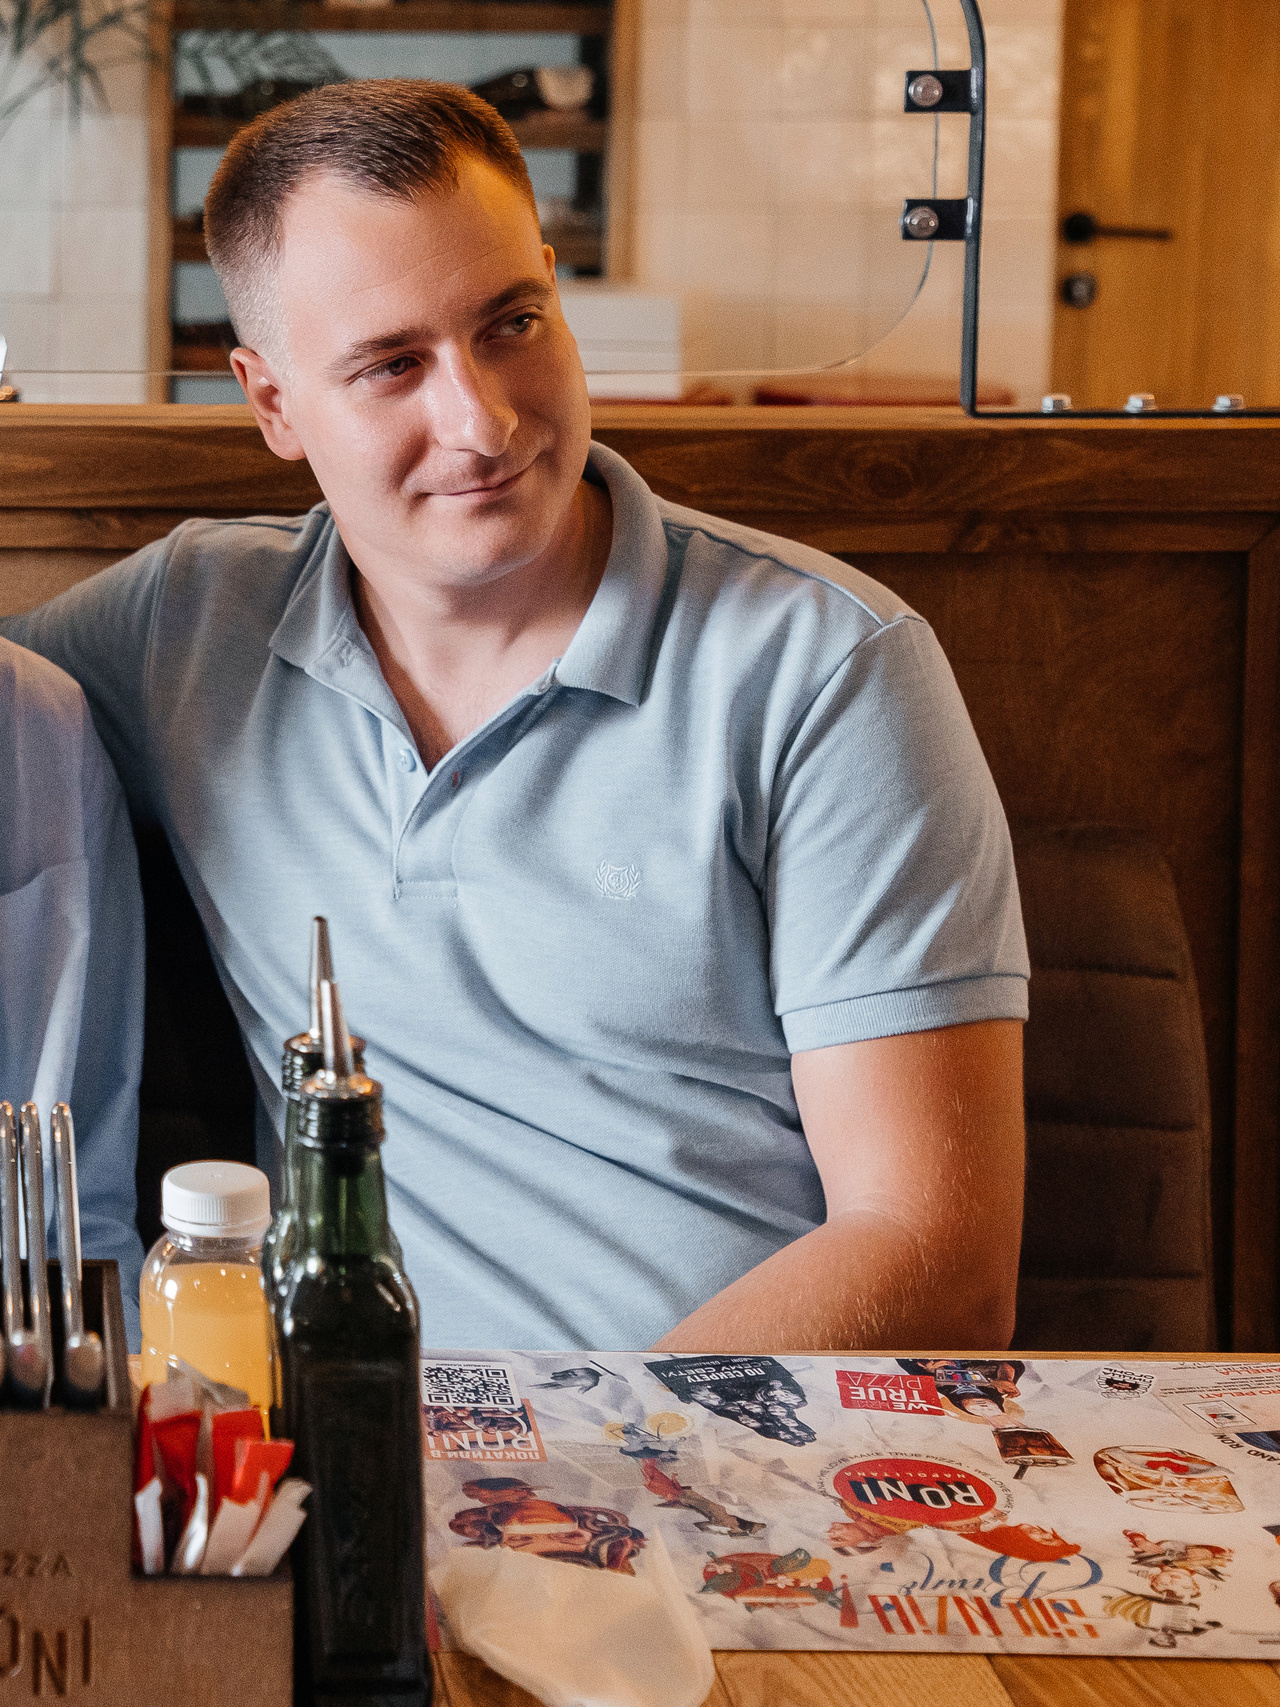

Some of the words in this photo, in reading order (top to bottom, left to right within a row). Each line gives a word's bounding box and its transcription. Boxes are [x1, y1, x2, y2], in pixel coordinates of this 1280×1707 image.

[721, 1361, 772, 1371] ВСЕМУ
[686, 1371, 744, 1383] СЕКРЕТУ
[1218, 1368, 1280, 1376] ARELLA
[846, 1373, 922, 1389] PIZZA
[849, 1386, 926, 1403] TRUE
[1198, 1390, 1256, 1399] PELATI
[892, 1402, 928, 1411] WE
[427, 1431, 538, 1451] RONI
[431, 1450, 441, 1458] В
[447, 1451, 540, 1459] ПОКАТИЛИ
[855, 1478, 984, 1509] RONI
